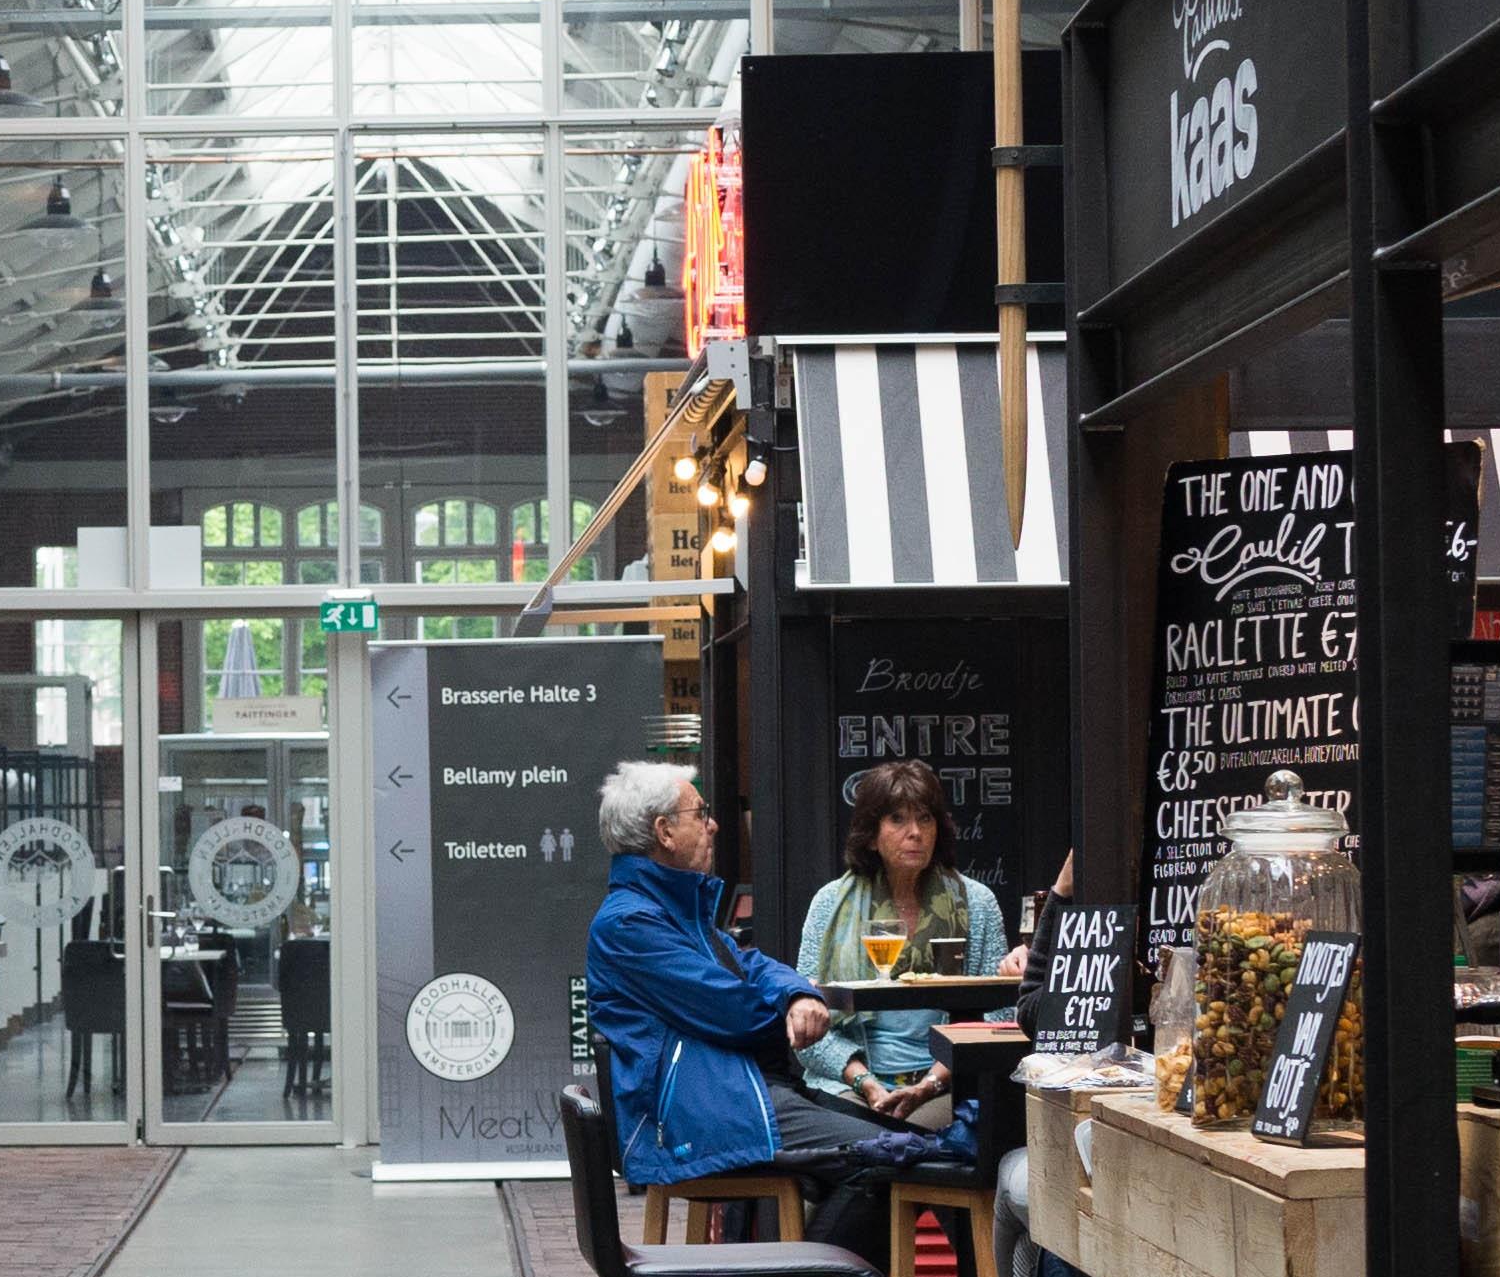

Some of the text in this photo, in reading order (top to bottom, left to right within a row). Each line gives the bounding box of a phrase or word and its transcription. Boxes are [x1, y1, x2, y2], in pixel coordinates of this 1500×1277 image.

[1170, 58, 1259, 228] kaas
[668, 481, 692, 494] Het
[1178, 464, 1344, 517] THE ONE AND
[670, 554, 694, 568] Het
[672, 627, 695, 641] Het
[1166, 612, 1309, 673] RACLETTE
[441, 685, 597, 706] Brasserie Halte 3
[856, 657, 984, 701] Broodje
[234, 709, 297, 719] TAITTINGER
[1160, 692, 1344, 749] THE ULTIMATE
[837, 714, 1010, 758] ENTRE
[443, 765, 568, 787] Bellamy plein
[842, 766, 1013, 806] CTE
[444, 840, 527, 860] Toiletten
[1166, 841, 1213, 860] SELECTION
[1216, 839, 1229, 855] OF
[1056, 910, 1125, 950] KAAS-
[1048, 953, 1121, 994] PLANK
[1296, 940, 1355, 1004] NOOTJES
[414, 979, 505, 1017] FOODHALLEN
[571, 976, 588, 1059] HALTE
[422, 1048, 500, 1076] AMSTERDAM
